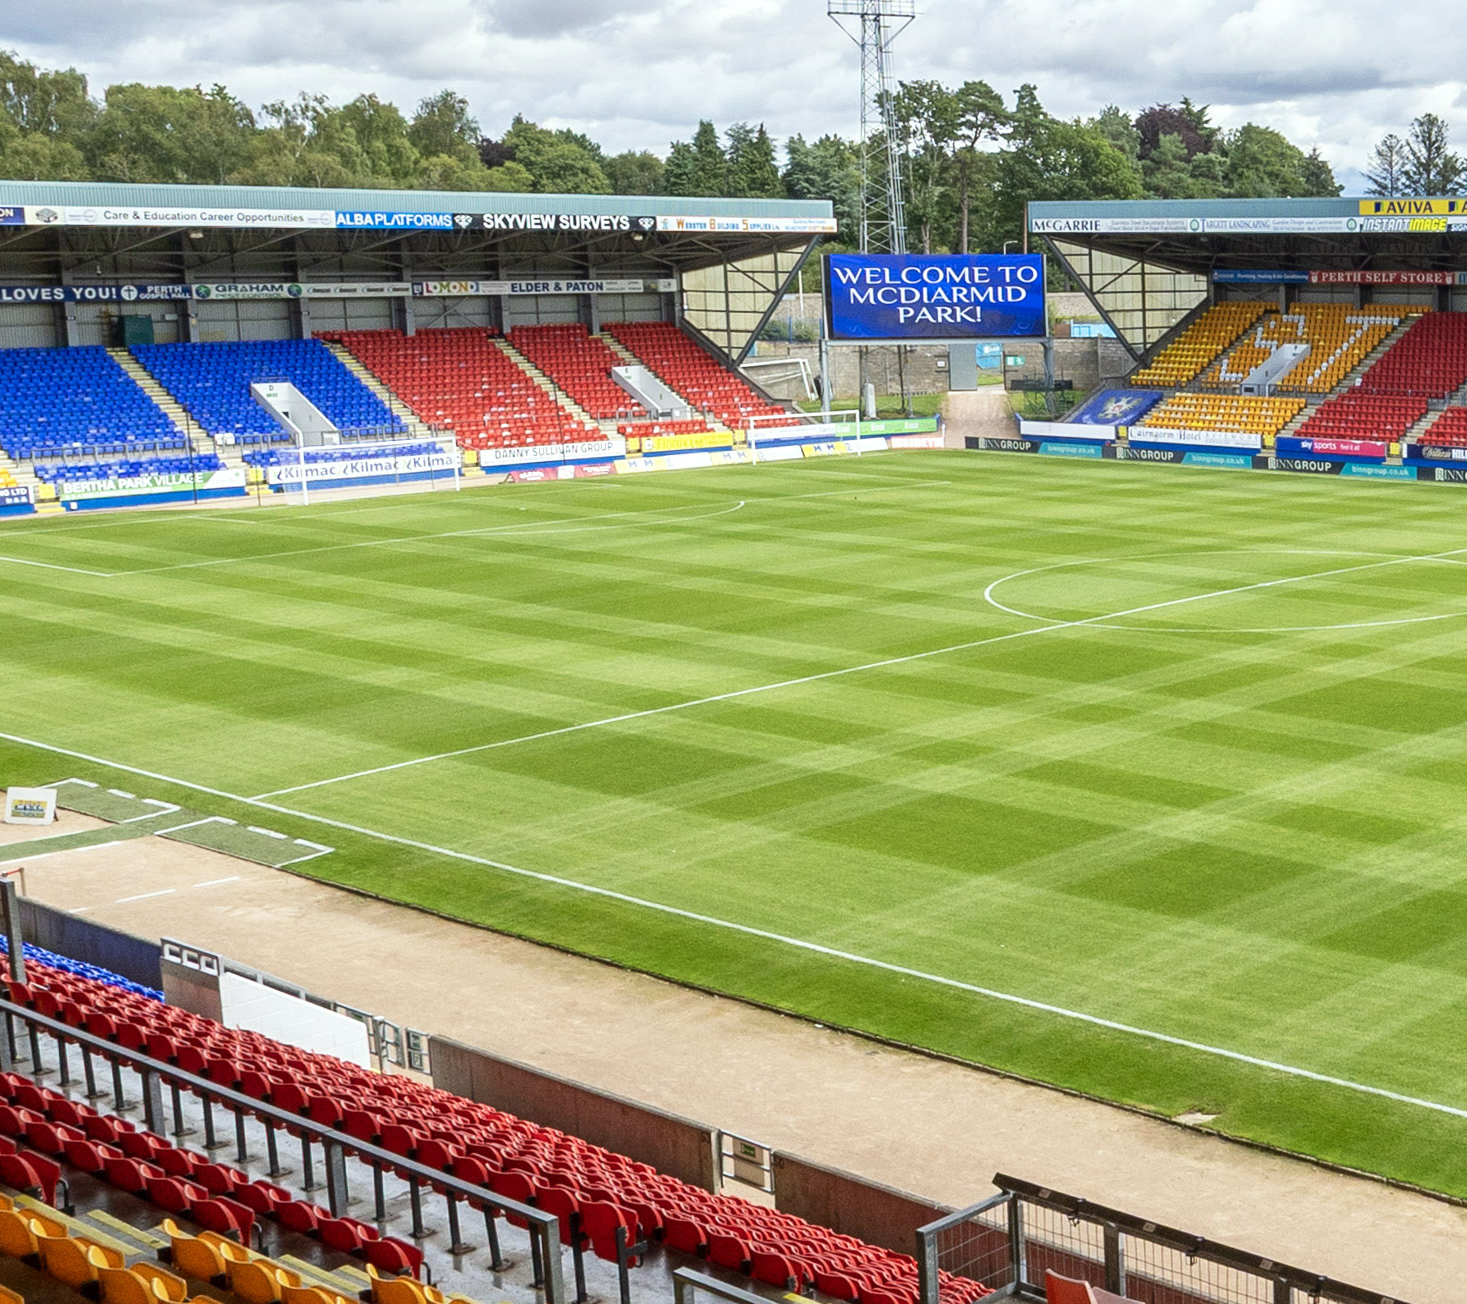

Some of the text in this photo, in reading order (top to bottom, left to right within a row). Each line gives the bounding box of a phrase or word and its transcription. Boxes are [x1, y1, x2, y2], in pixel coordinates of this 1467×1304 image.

[1386, 201, 1433, 213] AVIVA
[103, 211, 304, 224] Care & Education Career Opportunities
[336, 213, 452, 226] ALBA PLATFORMS
[483, 214, 630, 229] SKYVIEW SURVEYS
[834, 265, 1038, 284] WELCOME TO
[1322, 272, 1443, 283] PERTH SELF STORE
[2, 287, 64, 301] LOVES
[72, 287, 117, 299] YOU!
[147, 285, 182, 294] PERTH
[215, 284, 283, 293] GRAHAM
[511, 282, 549, 293] ELDER
[554, 282, 562, 292] &
[566, 282, 604, 292] PATON
[849, 286, 1027, 304] MCDIARMID
[897, 305, 982, 323] PARK!
[495, 441, 614, 459] DANNY SULLIVAN GROUP
[1301, 440, 1336, 451] sky sports
[350, 460, 399, 474] Kilmac
[1351, 466, 1409, 477] binngroup.co.uk
[63, 478, 115, 494] BERTHA
[118, 476, 153, 489] PARK
[155, 472, 204, 486] VILLAGE
[11, 488, 27, 497] LTD
